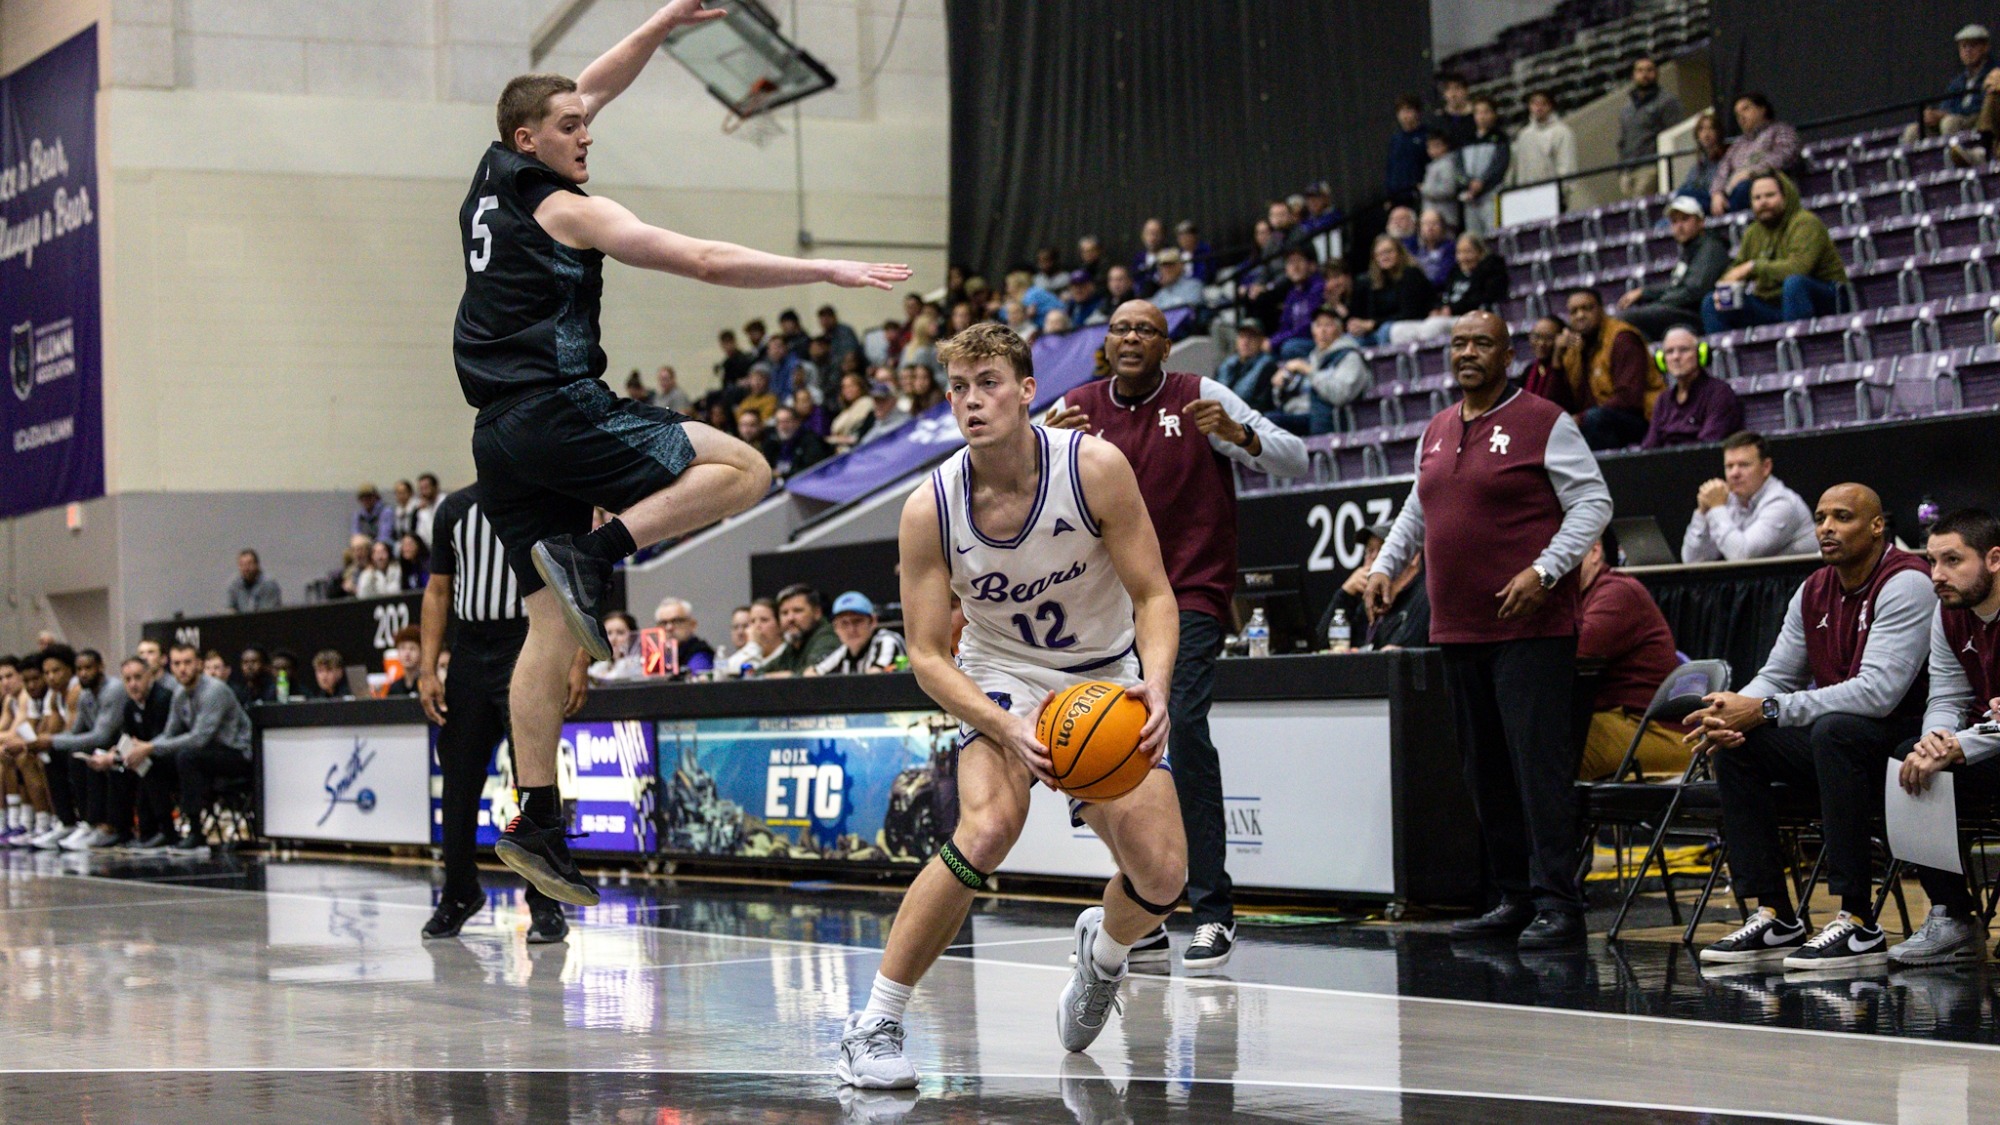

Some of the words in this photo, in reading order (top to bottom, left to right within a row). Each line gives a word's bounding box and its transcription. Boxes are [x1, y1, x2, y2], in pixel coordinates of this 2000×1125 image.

[469, 193, 500, 273] 5
[970, 560, 1088, 604] Bears
[1011, 599, 1081, 649] 12
[1055, 683, 1113, 750] Wilson
[769, 748, 809, 764] MOIX
[764, 763, 845, 820] ETC
[1226, 808, 1263, 836] ANK
